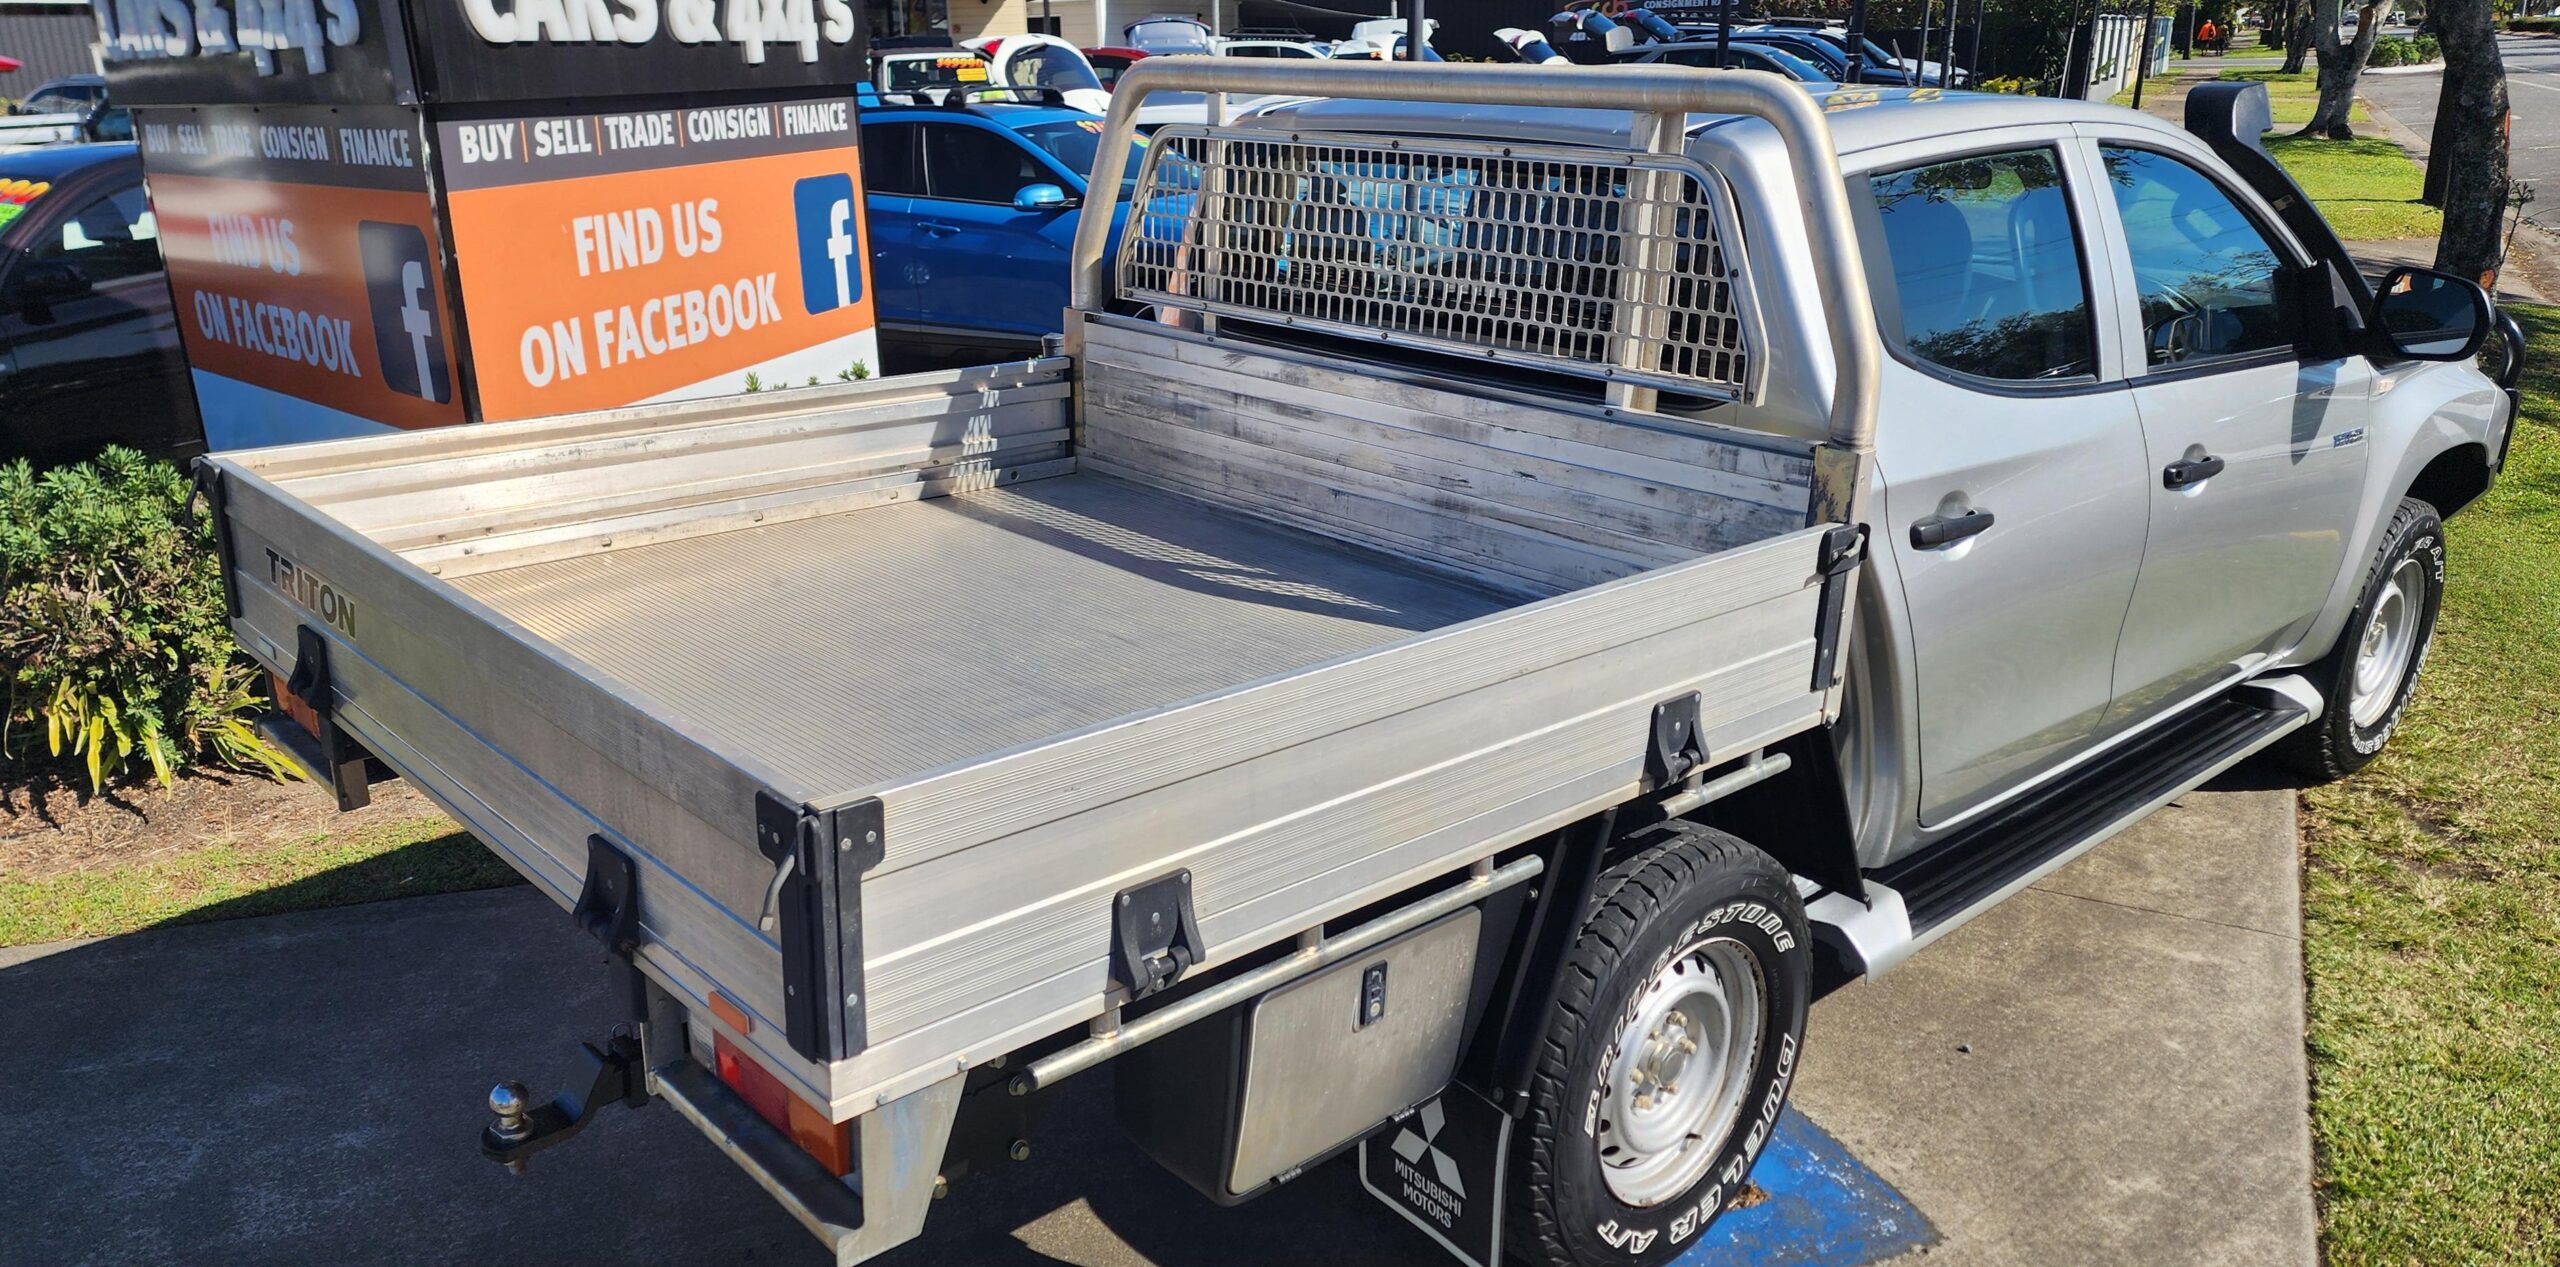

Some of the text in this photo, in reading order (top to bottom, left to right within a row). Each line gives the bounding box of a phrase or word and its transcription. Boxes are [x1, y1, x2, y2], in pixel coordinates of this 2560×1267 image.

[144, 124, 413, 168] BUY SELL TRADE CONSIGN FINANCE
[458, 102, 848, 164] BUY SELL TRADE CONSIGN FINANCE
[208, 210, 300, 277] FIND US
[572, 197, 723, 277] FIND US
[194, 290, 362, 378] ON FACEBOOK
[520, 272, 782, 389] ON FACEBOOK
[265, 546, 356, 640] TRITON
[1584, 902, 1796, 1138] BRIDGESTONE
[1597, 1032, 1797, 1254] DUELER A/T
[1395, 1158, 1462, 1217] MITSUBISHI
[1404, 1182, 1452, 1229] MOTORS
